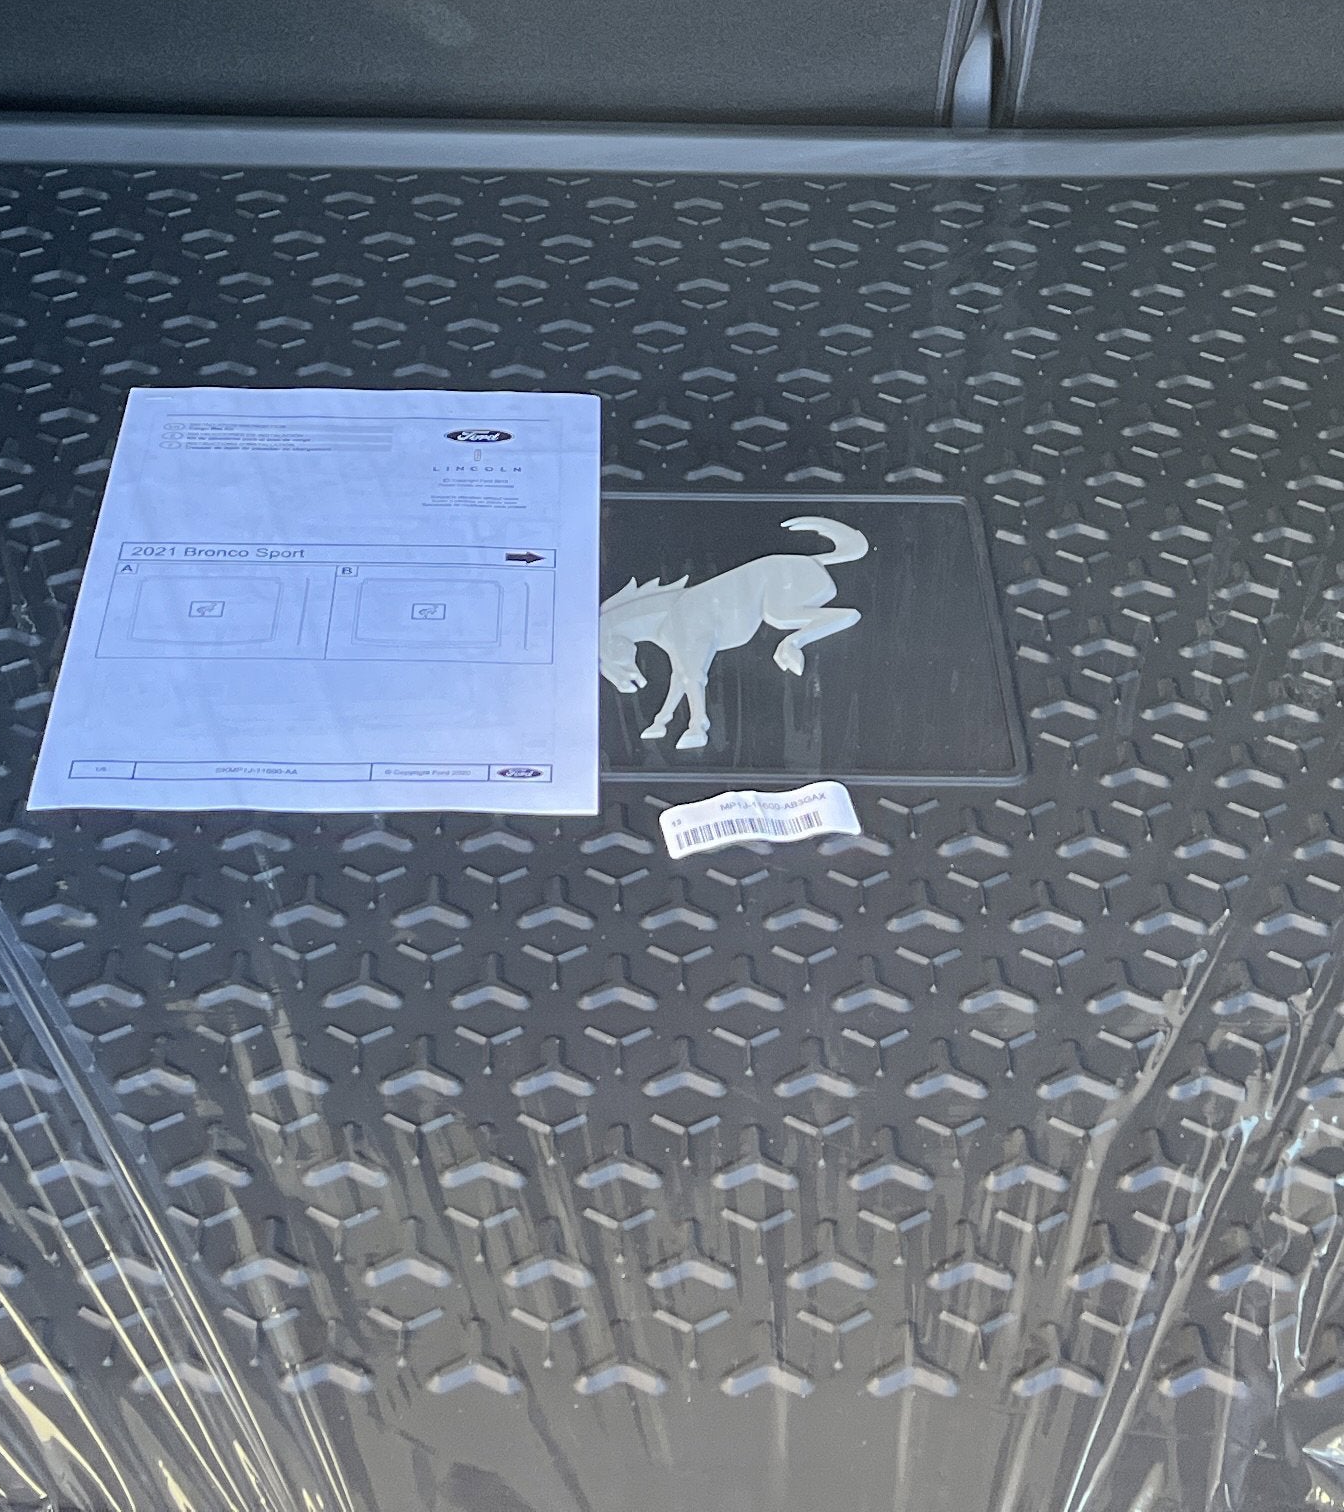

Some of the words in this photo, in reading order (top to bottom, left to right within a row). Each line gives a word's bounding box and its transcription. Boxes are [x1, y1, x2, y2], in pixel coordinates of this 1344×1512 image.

[130, 545, 176, 558] 2021
[184, 546, 249, 559] Bronco
[256, 547, 305, 561] Sport
[120, 564, 133, 573] A
[341, 566, 353, 575] B
